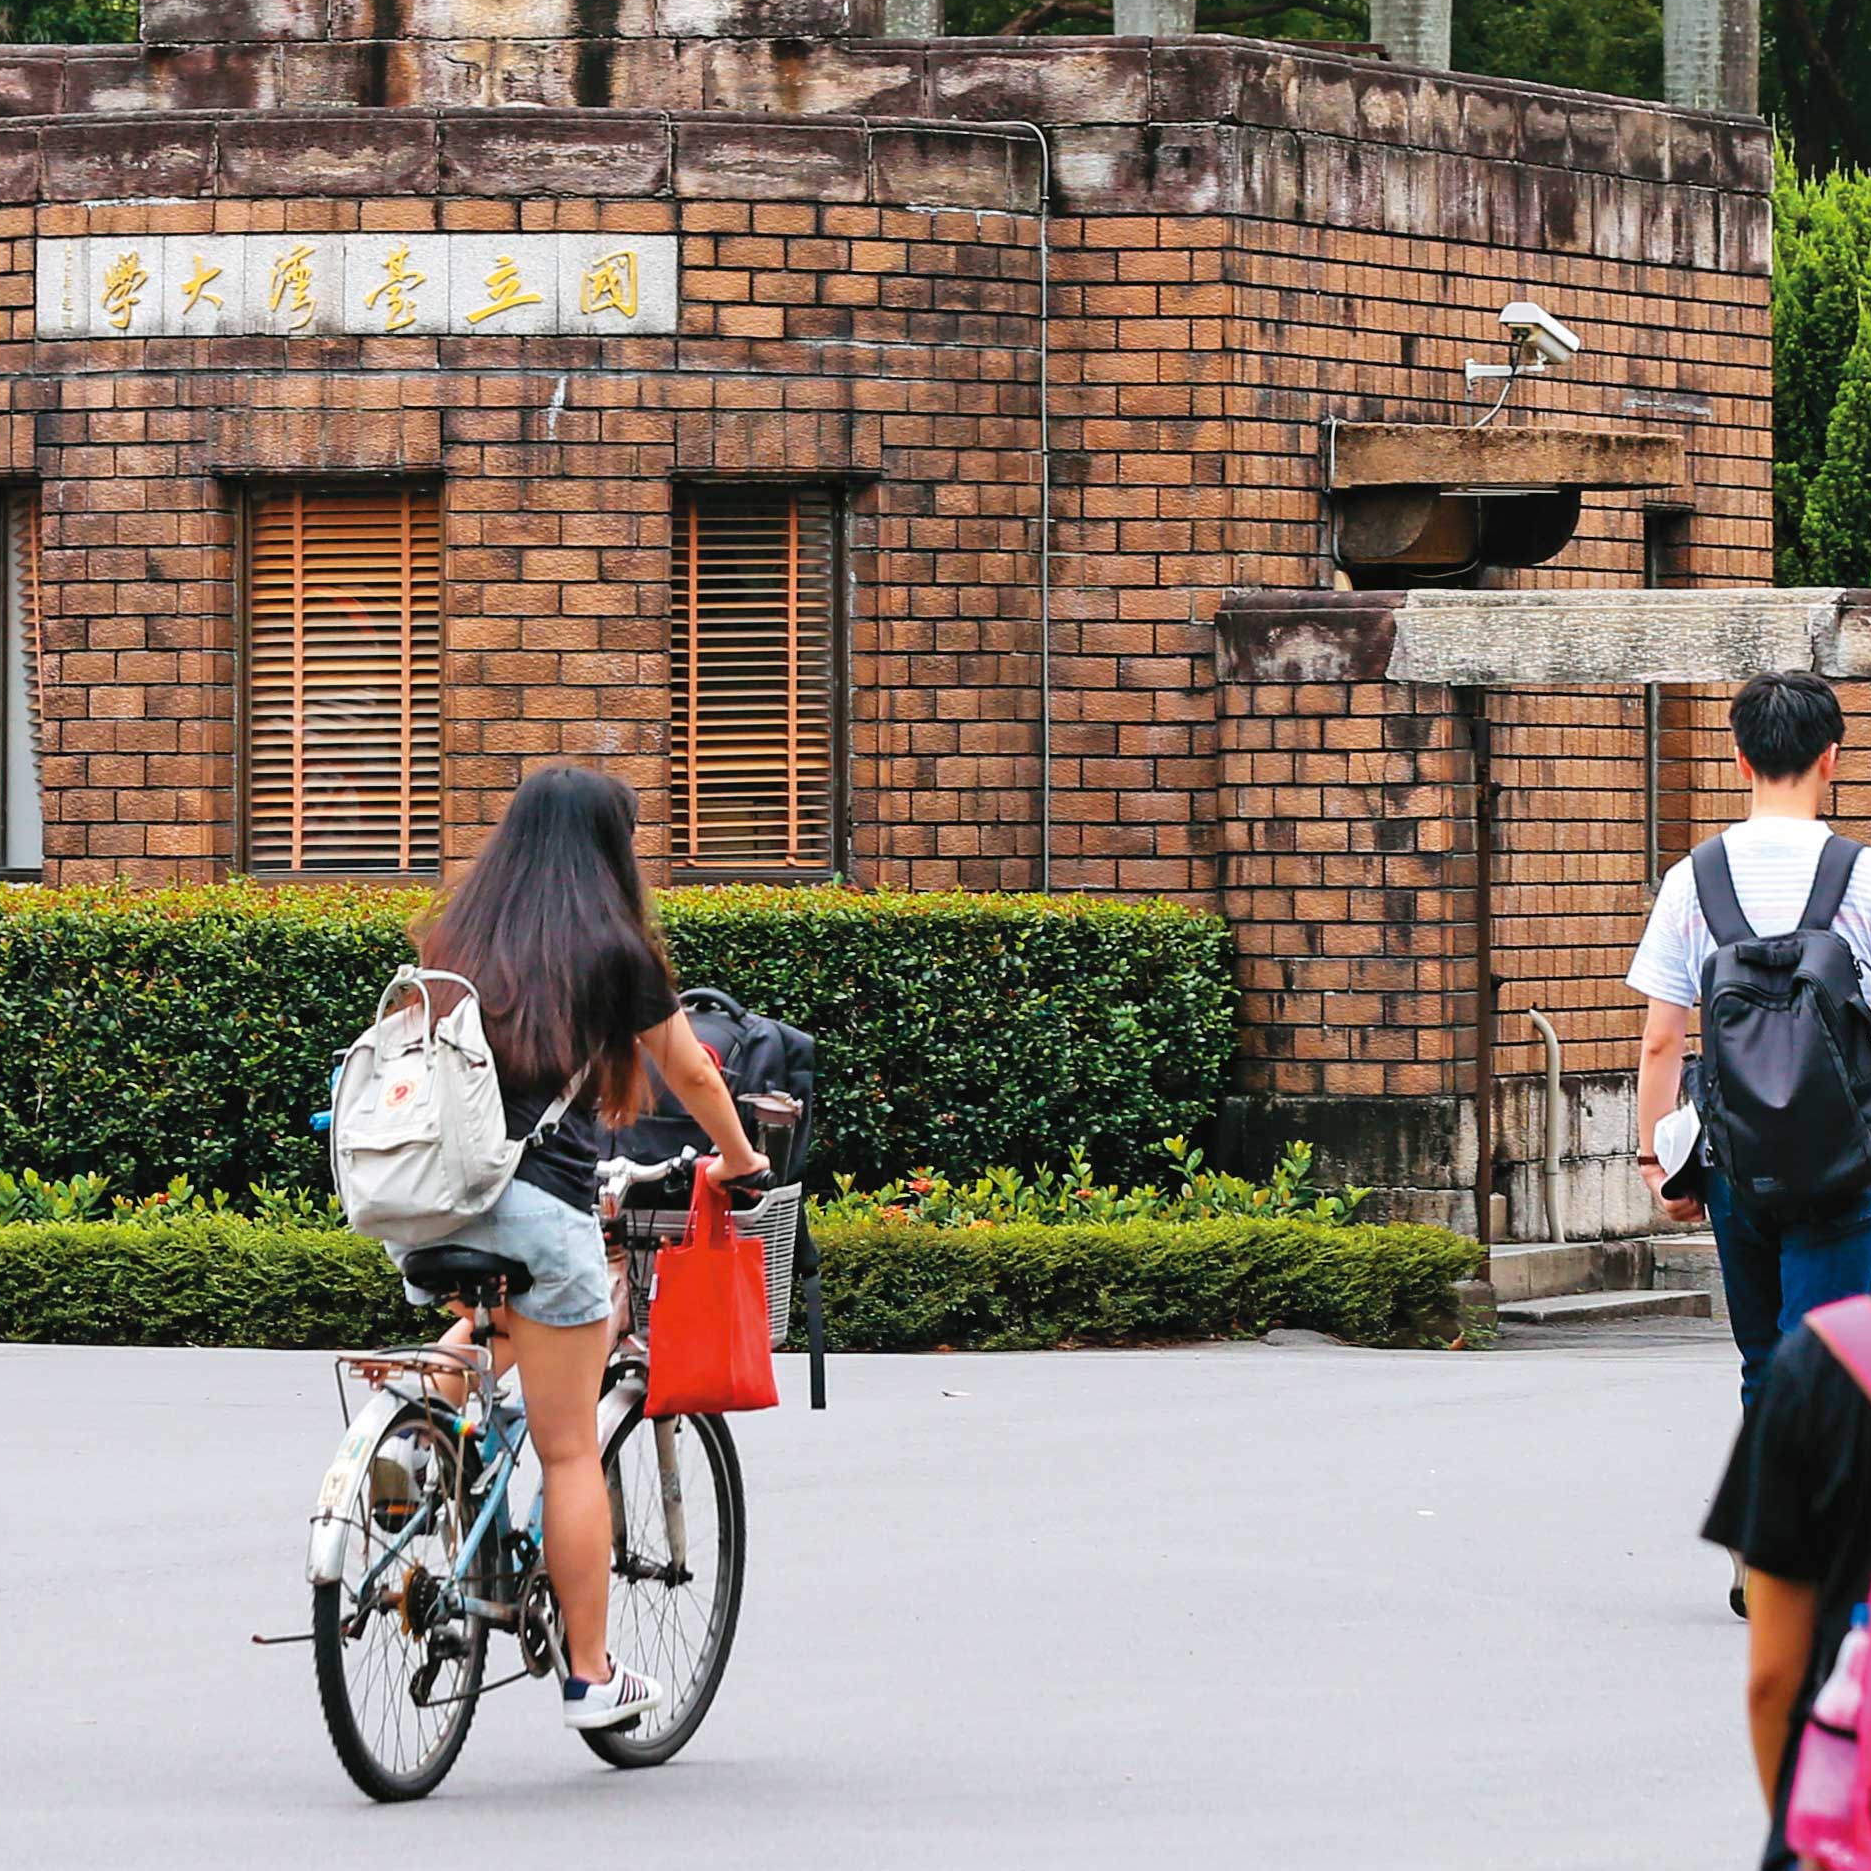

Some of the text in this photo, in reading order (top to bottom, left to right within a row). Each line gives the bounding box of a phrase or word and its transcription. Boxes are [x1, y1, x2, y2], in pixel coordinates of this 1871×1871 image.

[100, 242, 639, 331] 國立臺灣大學
